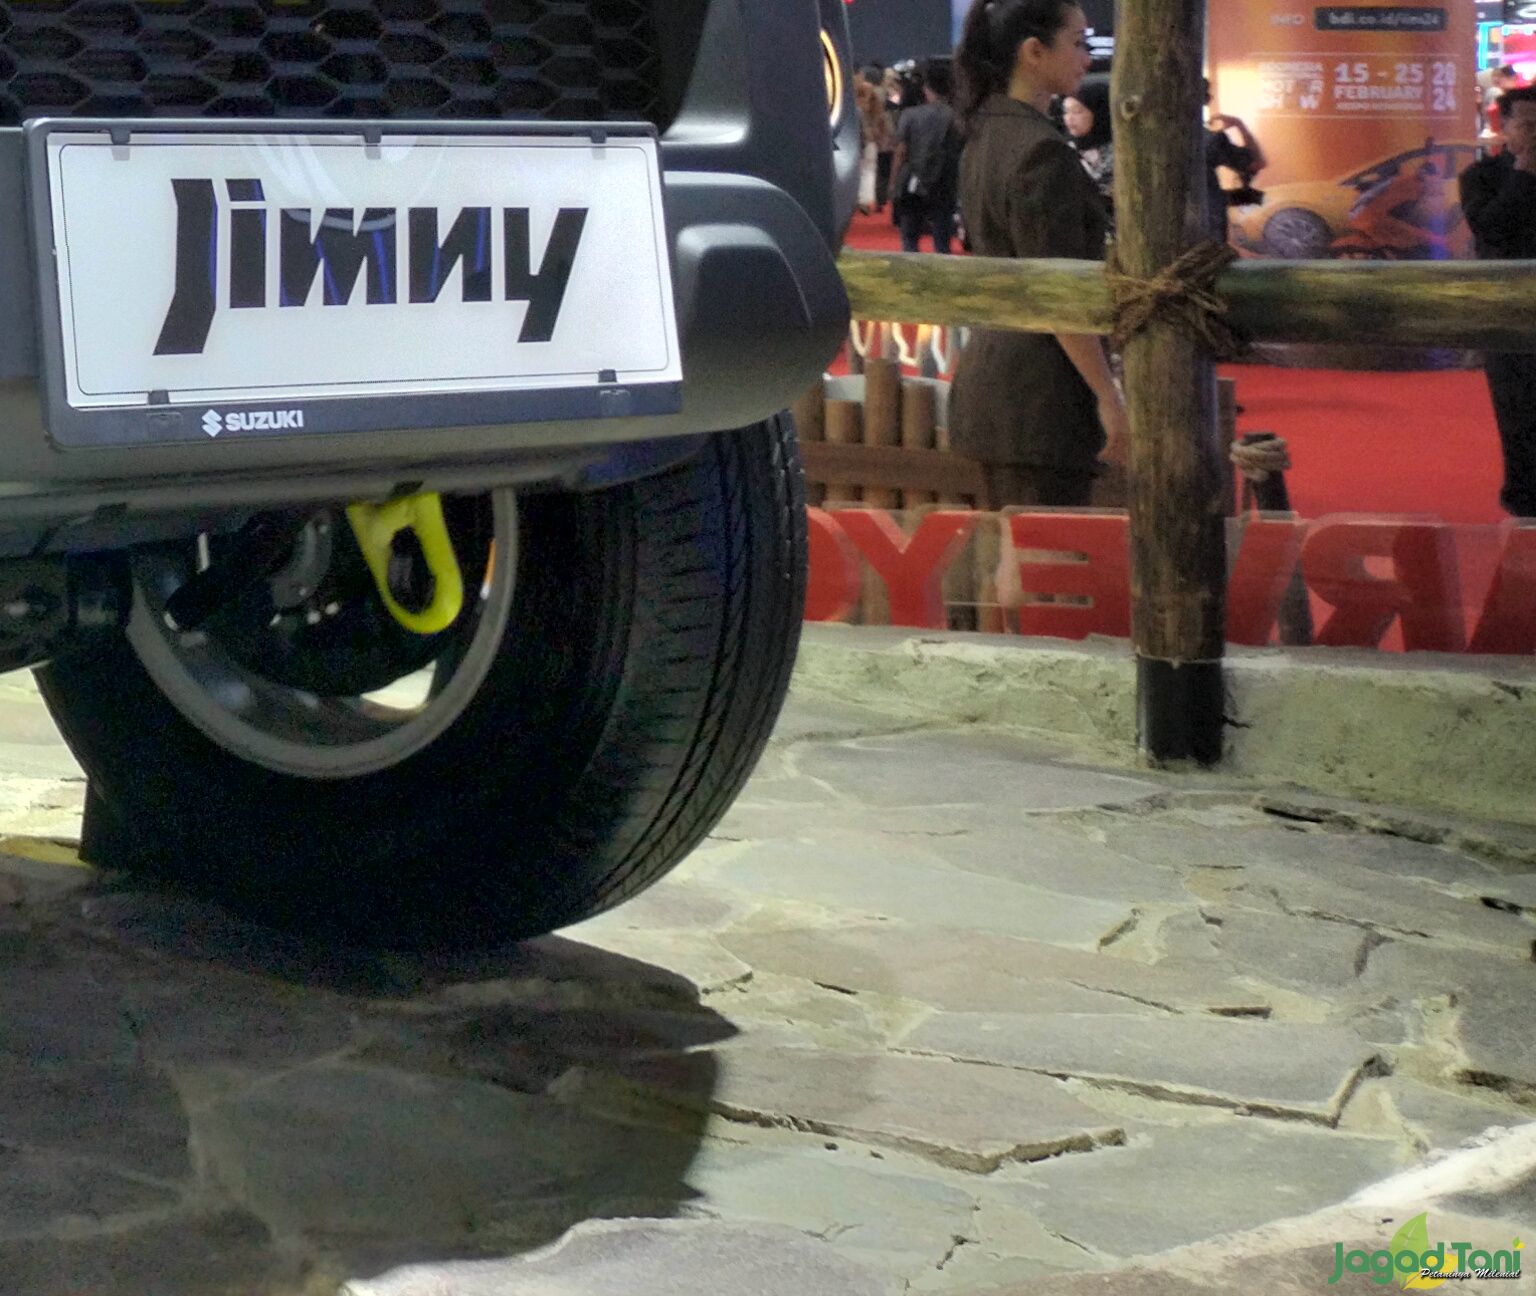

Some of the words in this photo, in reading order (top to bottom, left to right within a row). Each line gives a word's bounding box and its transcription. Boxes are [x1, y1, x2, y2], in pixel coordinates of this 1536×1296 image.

[1334, 62, 1369, 83] 15
[1395, 62, 1424, 83] 25
[1334, 85, 1424, 99] FEBRUARY
[153, 178, 589, 355] Jimny
[225, 409, 305, 432] SUZUKI
